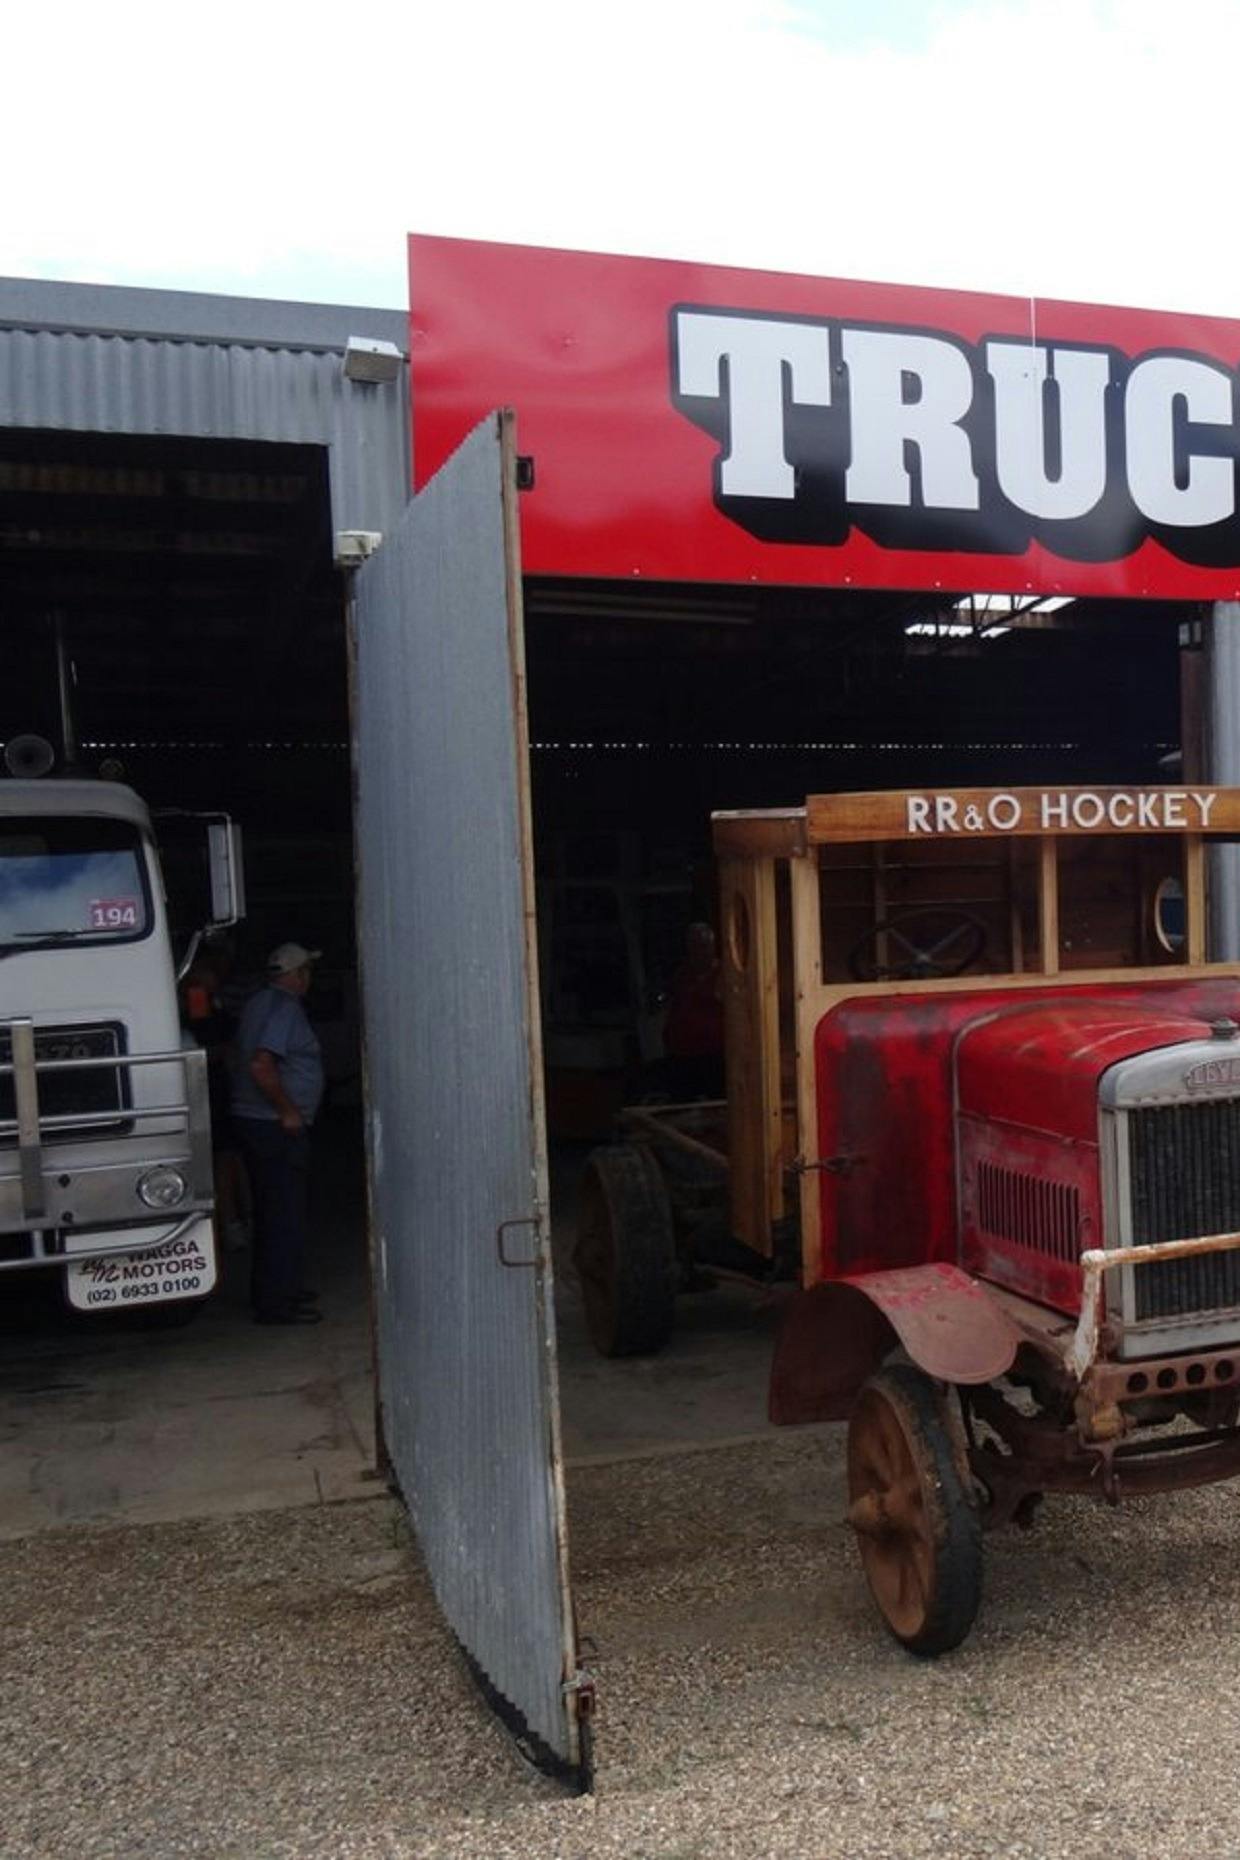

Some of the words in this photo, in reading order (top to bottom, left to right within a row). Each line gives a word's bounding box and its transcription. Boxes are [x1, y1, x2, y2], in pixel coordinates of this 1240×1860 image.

[907, 794, 1022, 833] RR&O
[1041, 793, 1216, 828] HOCKEY
[94, 907, 135, 927] 194
[123, 1256, 207, 1280] MOTORS
[87, 1289, 117, 1304] (02)
[121, 1283, 160, 1299] 6933
[162, 1277, 201, 1293] 0100
